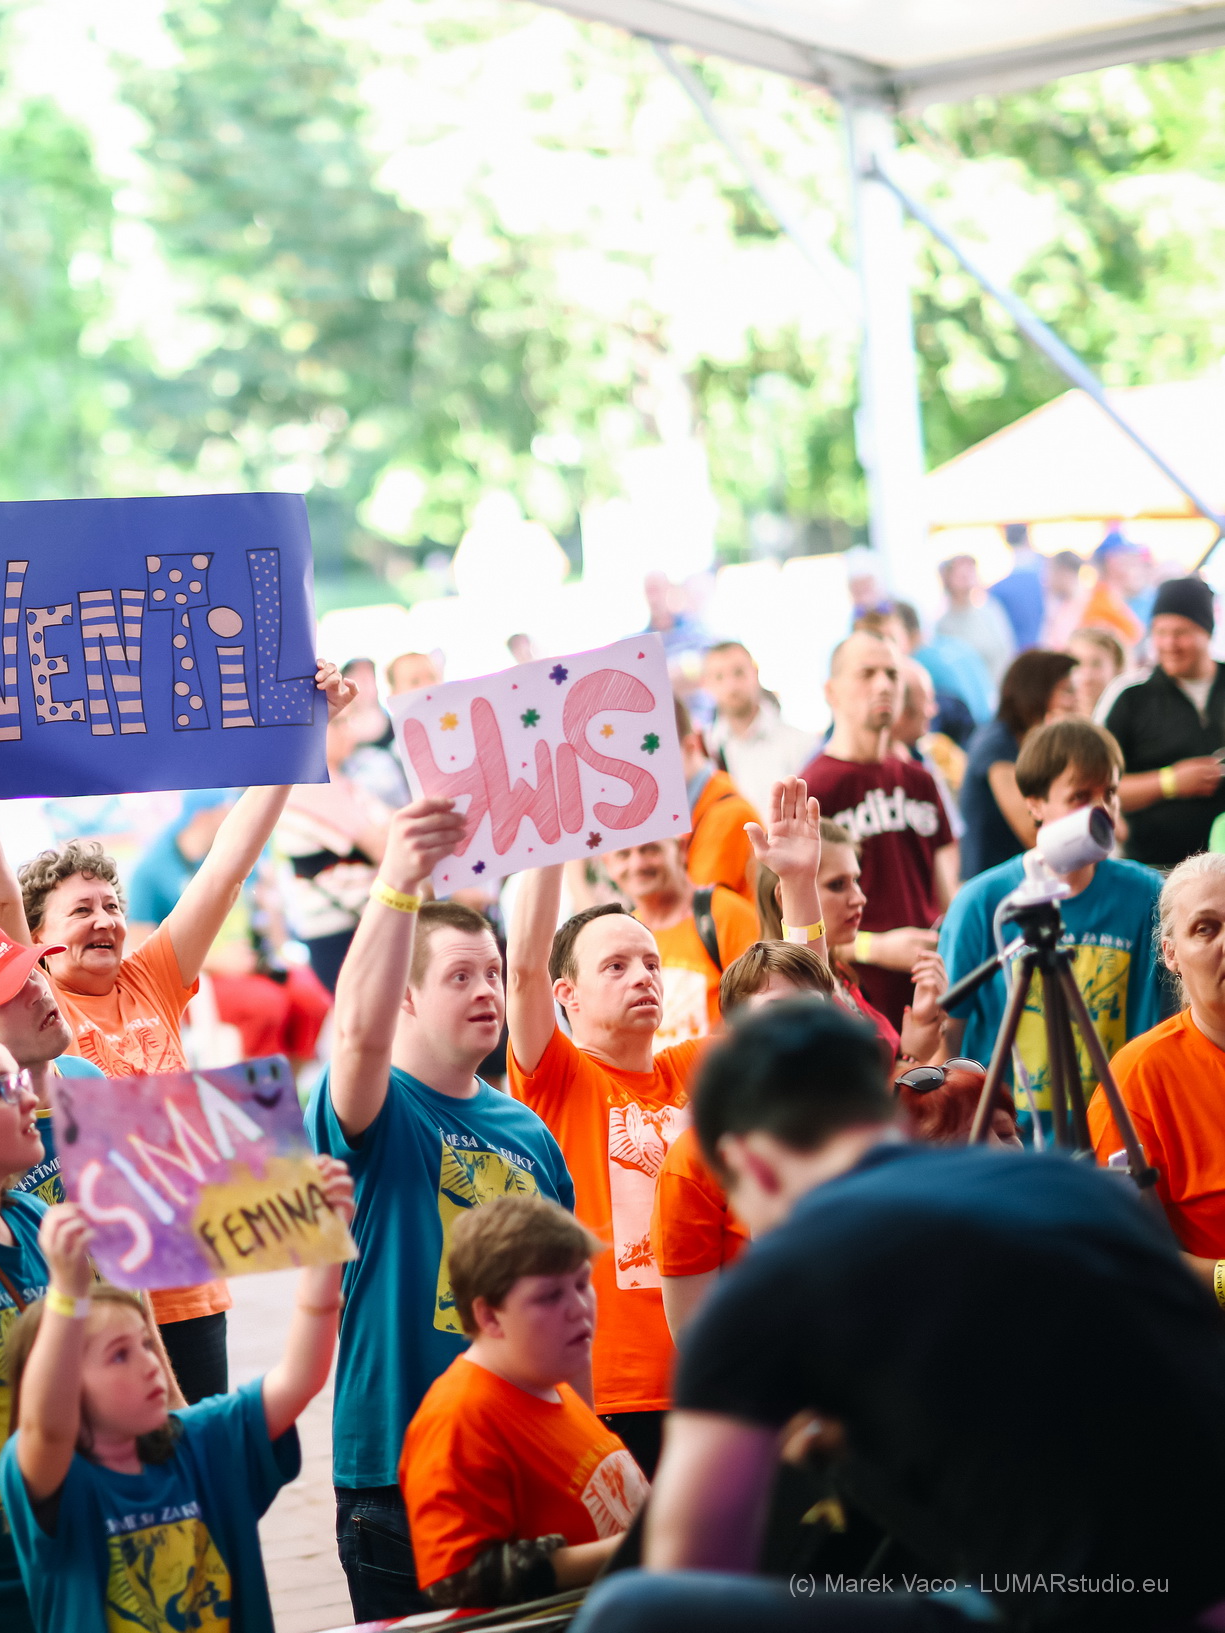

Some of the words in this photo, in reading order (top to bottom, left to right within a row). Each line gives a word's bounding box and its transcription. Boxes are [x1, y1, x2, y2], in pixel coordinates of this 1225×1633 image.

[79, 1073, 265, 1273] SIMA
[499, 1147, 536, 1171] RUKY
[199, 1181, 336, 1270] FEMINA
